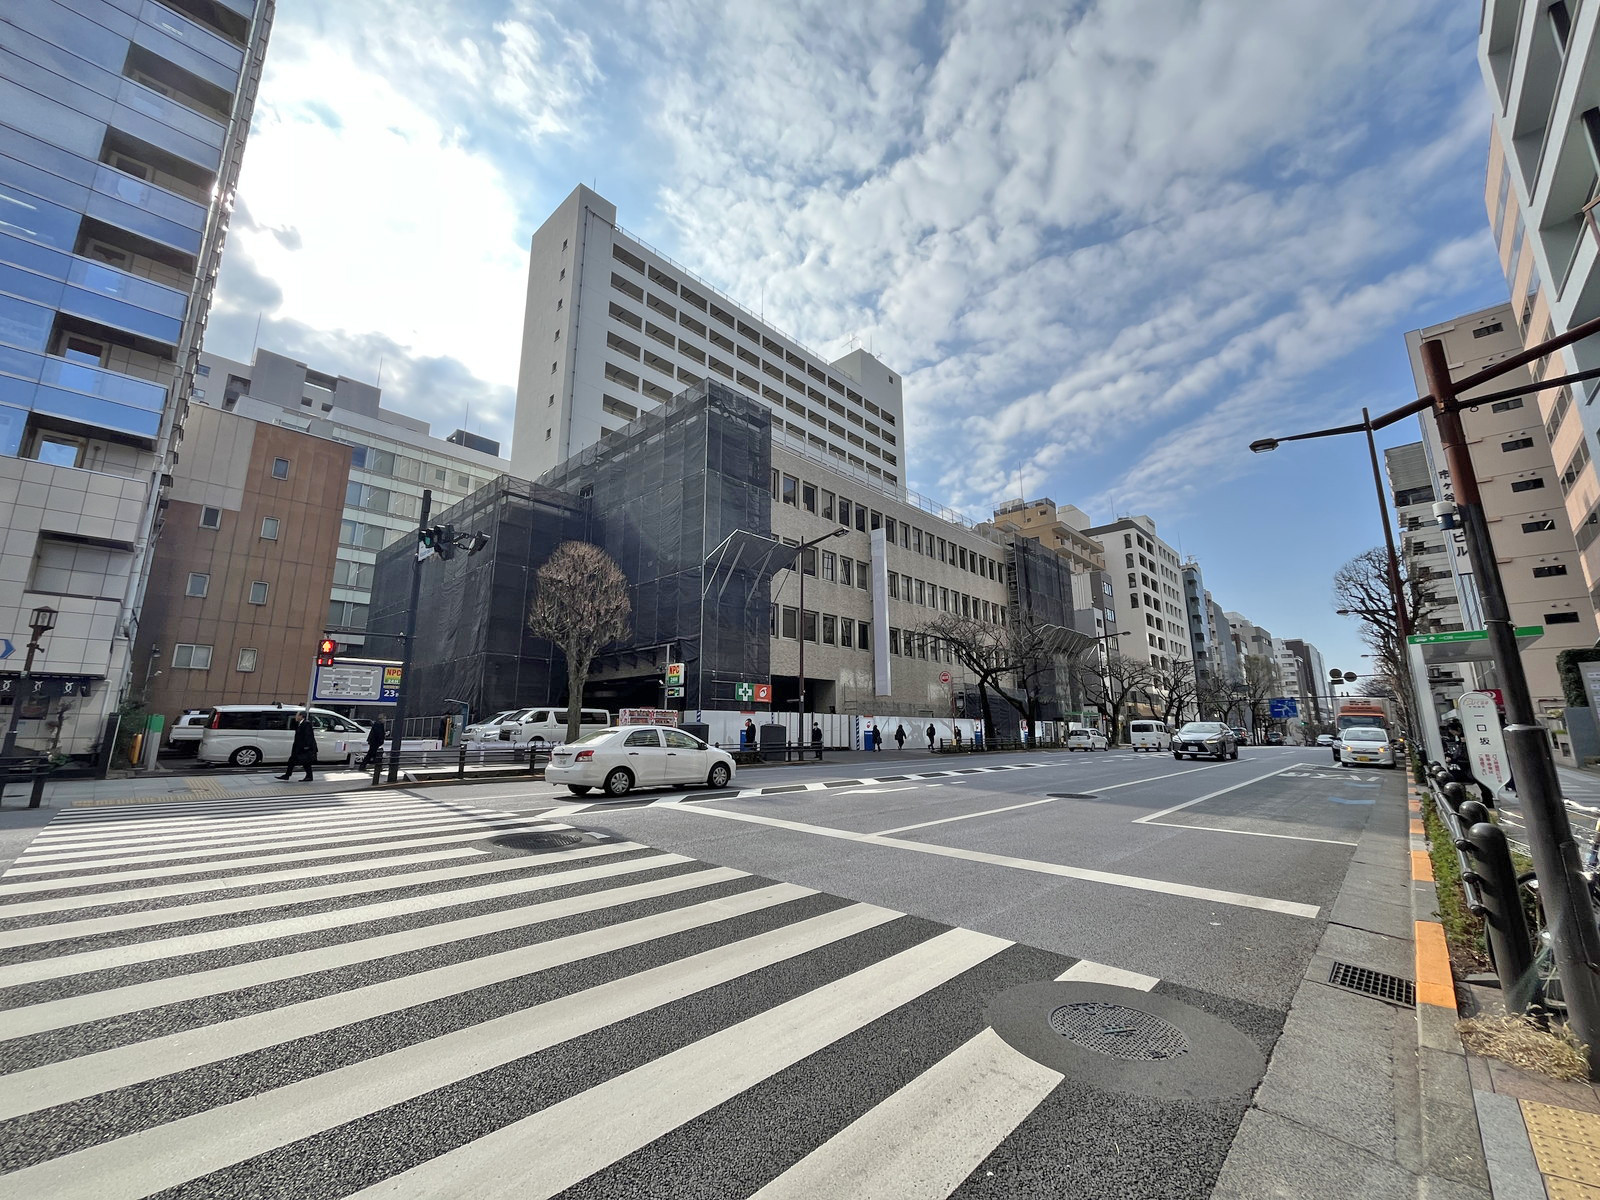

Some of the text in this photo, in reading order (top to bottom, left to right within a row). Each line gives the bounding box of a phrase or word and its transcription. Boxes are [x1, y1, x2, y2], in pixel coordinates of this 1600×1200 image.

[1438, 469, 1468, 557] 市ヶ谷ビル
[386, 668, 402, 676] NPC
[1474, 714, 1491, 746] 一口坂
